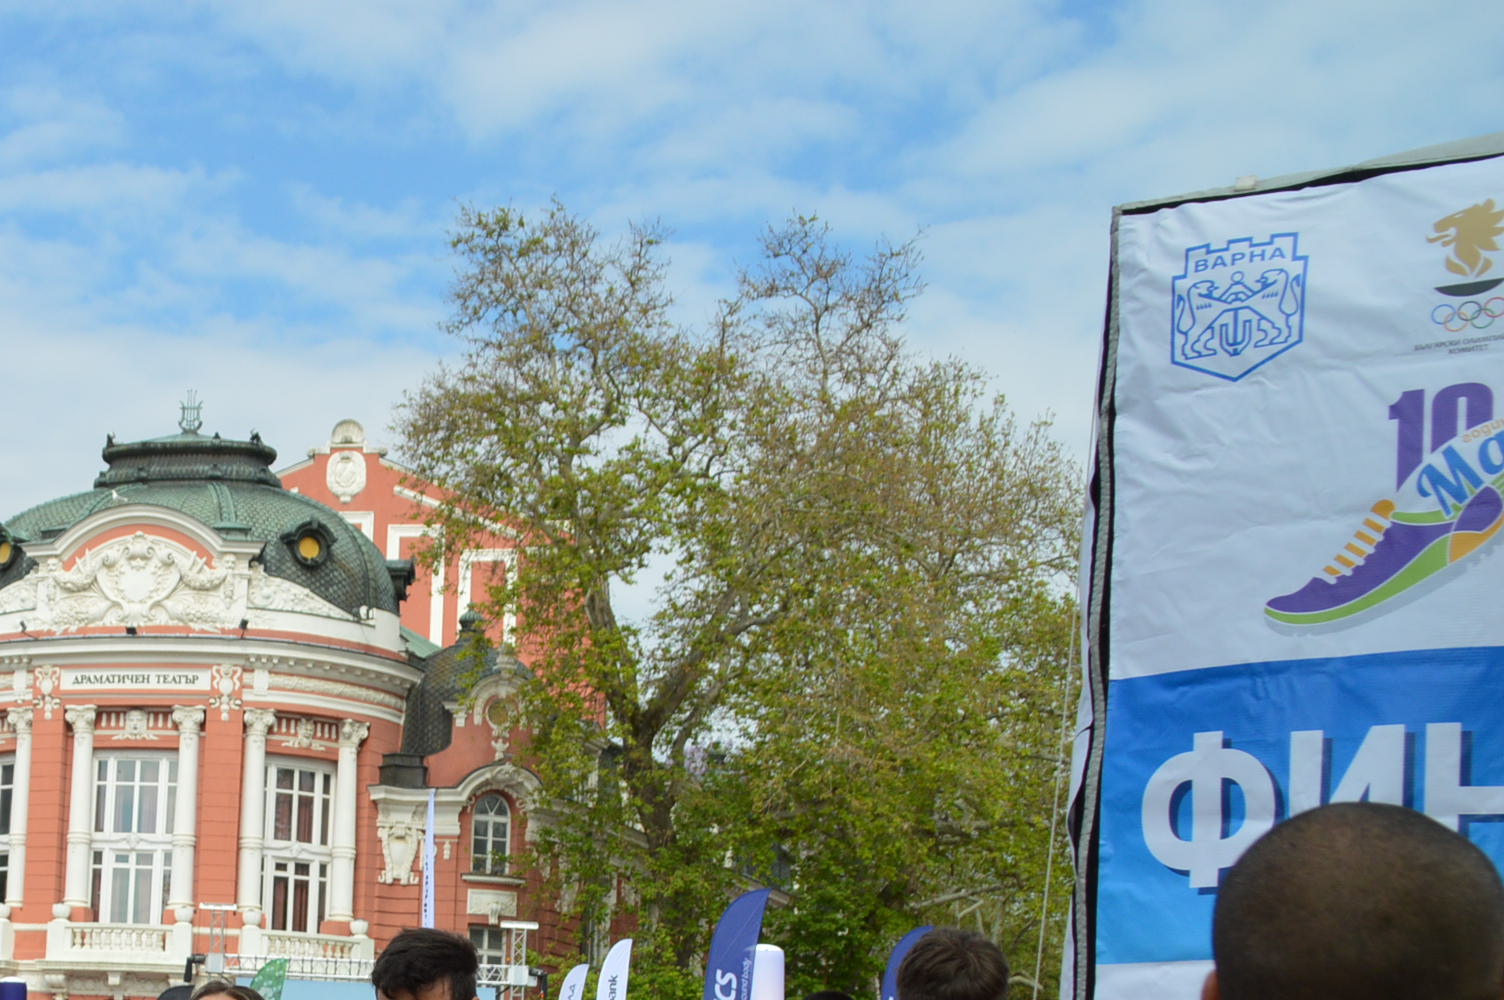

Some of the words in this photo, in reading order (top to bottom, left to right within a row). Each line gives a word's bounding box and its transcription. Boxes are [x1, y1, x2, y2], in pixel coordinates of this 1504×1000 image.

[1193, 244, 1287, 274] ВАРНА
[72, 673, 150, 685] ДРАМАТИЧЕН
[155, 673, 199, 685] ТЕАТЪР
